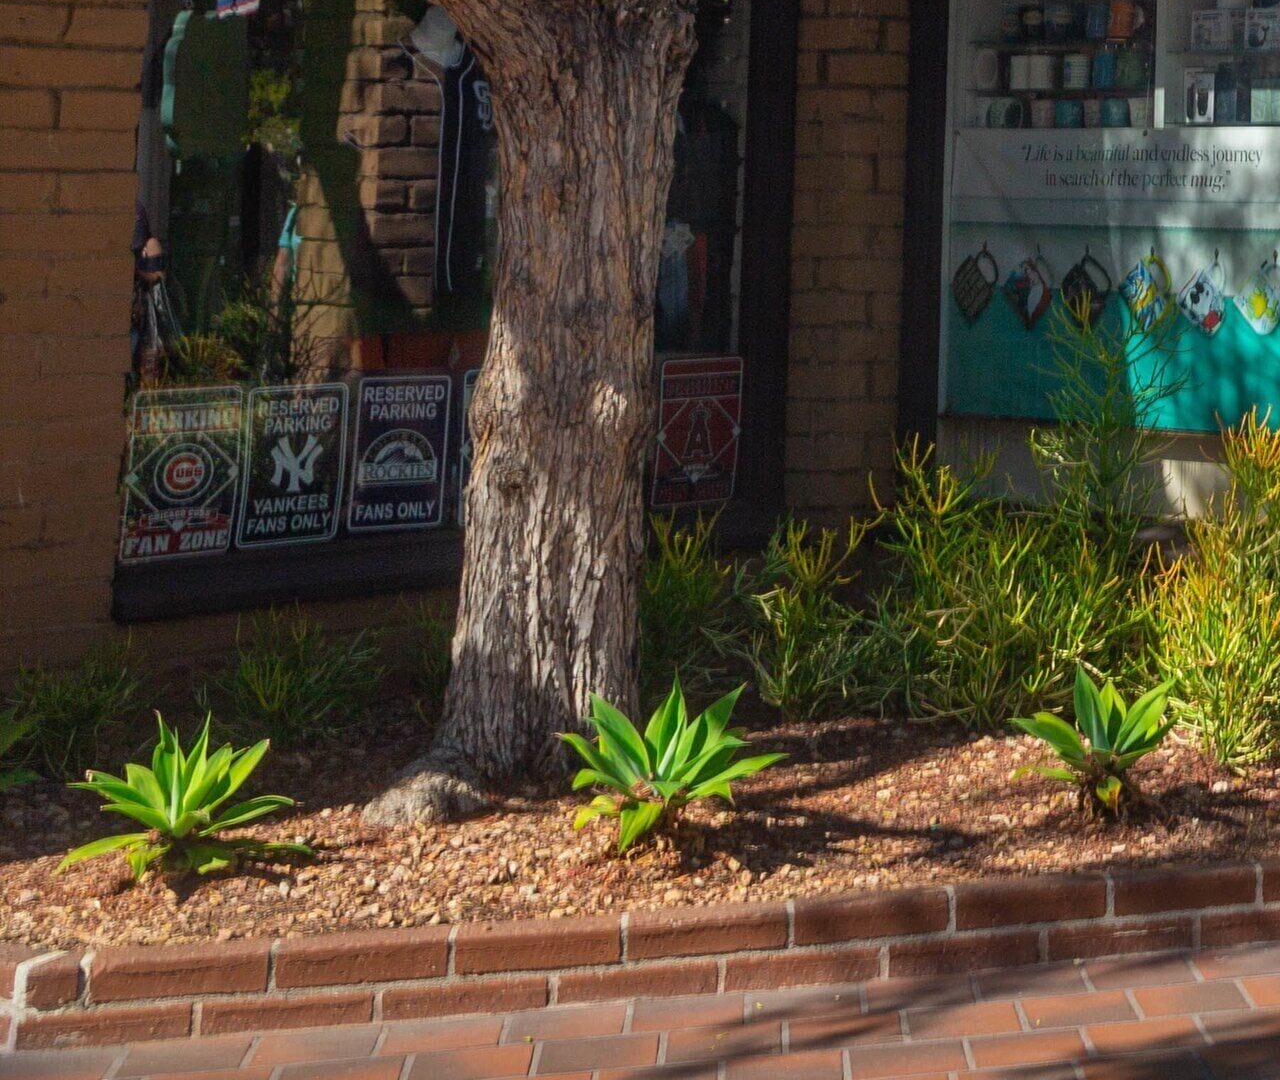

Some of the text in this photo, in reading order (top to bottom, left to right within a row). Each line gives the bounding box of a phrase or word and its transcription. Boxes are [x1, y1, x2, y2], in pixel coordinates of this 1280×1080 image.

[1053, 145, 1063, 161] is
[1065, 150, 1073, 161] a
[1075, 144, 1130, 162] beautiful
[1132, 144, 1159, 161] and
[1161, 144, 1210, 161] endless
[1211, 146, 1263, 167] journey
[1045, 170, 1057, 185] in
[1059, 170, 1098, 186] search
[1100, 170, 1115, 186] of
[1117, 170, 1138, 186] the
[1142, 169, 1186, 191] perfect
[364, 385, 445, 403] RESERVED
[258, 397, 339, 419] RESERVED
[370, 403, 437, 420] PARKING
[139, 407, 236, 432] PARKING
[264, 415, 332, 436] PARKING
[362, 462, 434, 479] ROCKIES
[253, 493, 329, 515] YANKEES
[355, 500, 436, 522] FANS ONLY
[246, 511, 332, 536] FANS ONLY
[125, 528, 229, 555] FAN ZONE
